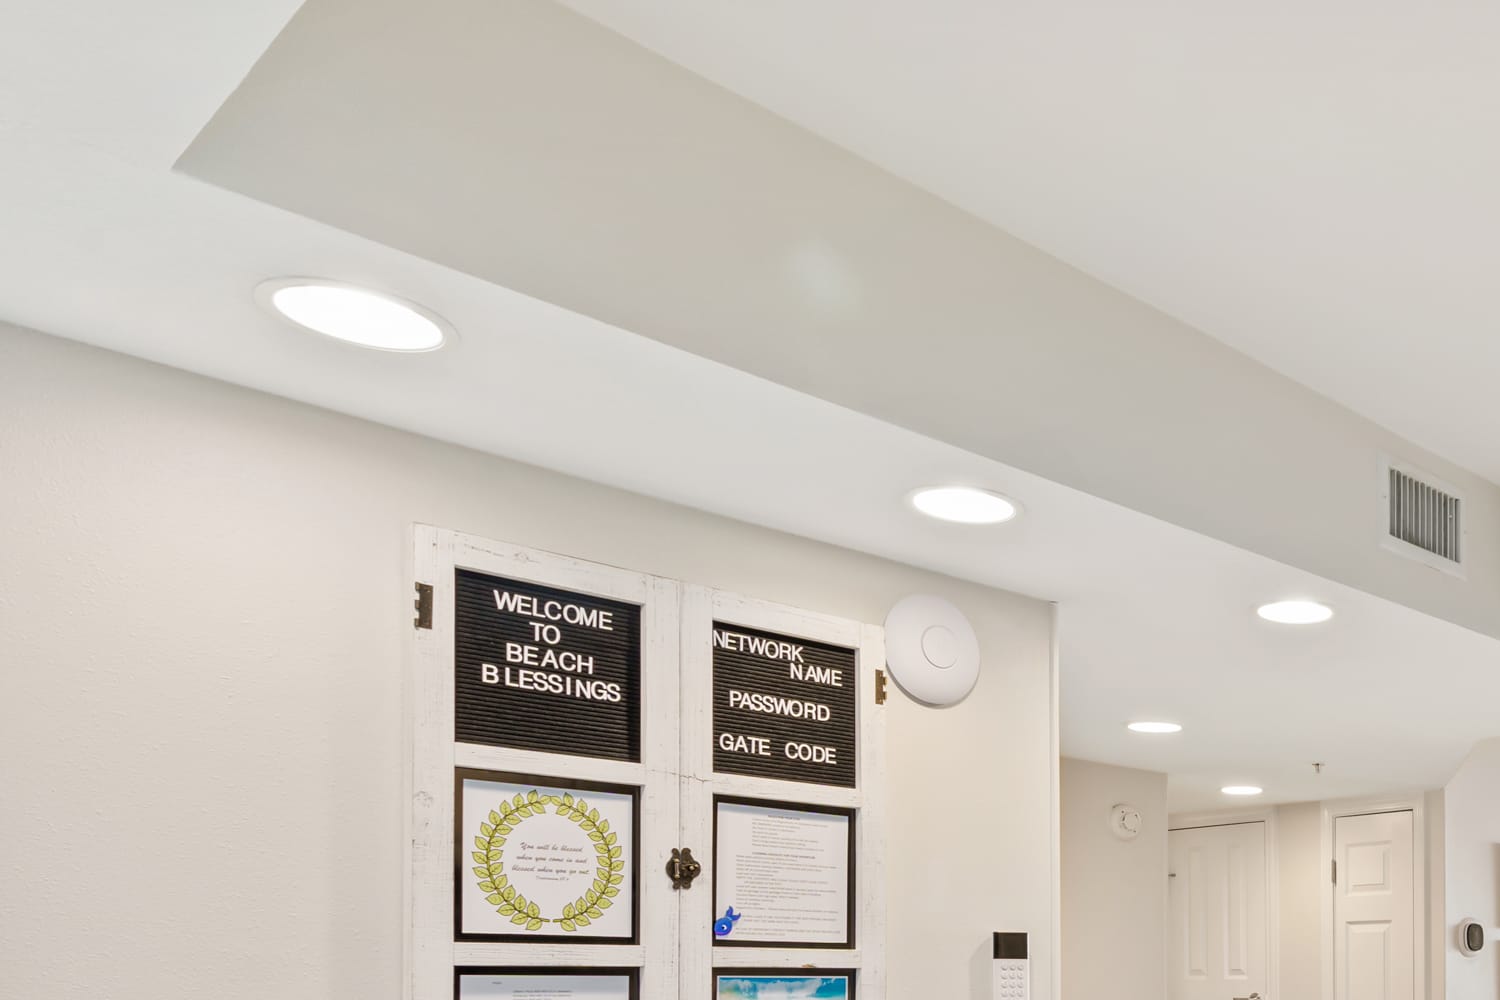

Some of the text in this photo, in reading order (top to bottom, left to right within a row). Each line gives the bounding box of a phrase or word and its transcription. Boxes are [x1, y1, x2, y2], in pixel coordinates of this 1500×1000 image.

[493, 589, 613, 631] WELCOME
[529, 621, 561, 644] TO
[713, 630, 804, 663] NETWORK
[506, 642, 593, 675] BEACH
[790, 662, 843, 687] NAME
[481, 663, 621, 702] BLESSINGS
[729, 690, 830, 721] PASSWORD
[719, 733, 837, 764] GATE CODE
